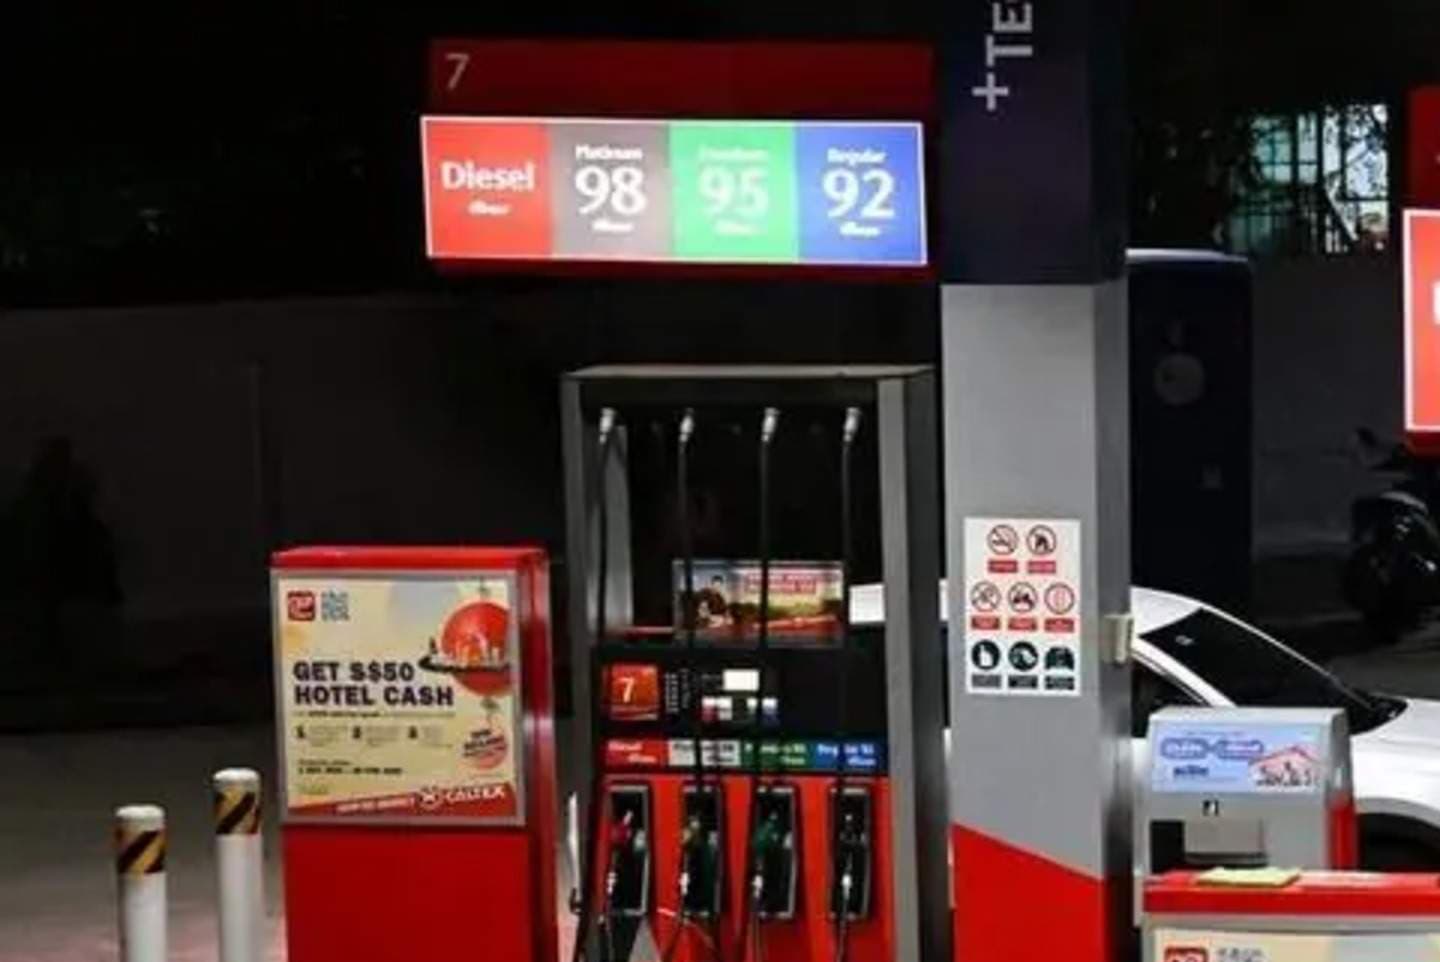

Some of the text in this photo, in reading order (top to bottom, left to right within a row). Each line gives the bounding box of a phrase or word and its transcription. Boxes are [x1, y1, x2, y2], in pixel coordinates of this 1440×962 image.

[446, 53, 470, 89] 7
[441, 160, 536, 190] Diesel
[574, 165, 648, 215] 98
[699, 166, 769, 218] 95
[822, 168, 895, 219] 92
[293, 660, 415, 683] GET S$50
[294, 686, 454, 706] HOTEL CASH
[617, 677, 635, 704] 7
